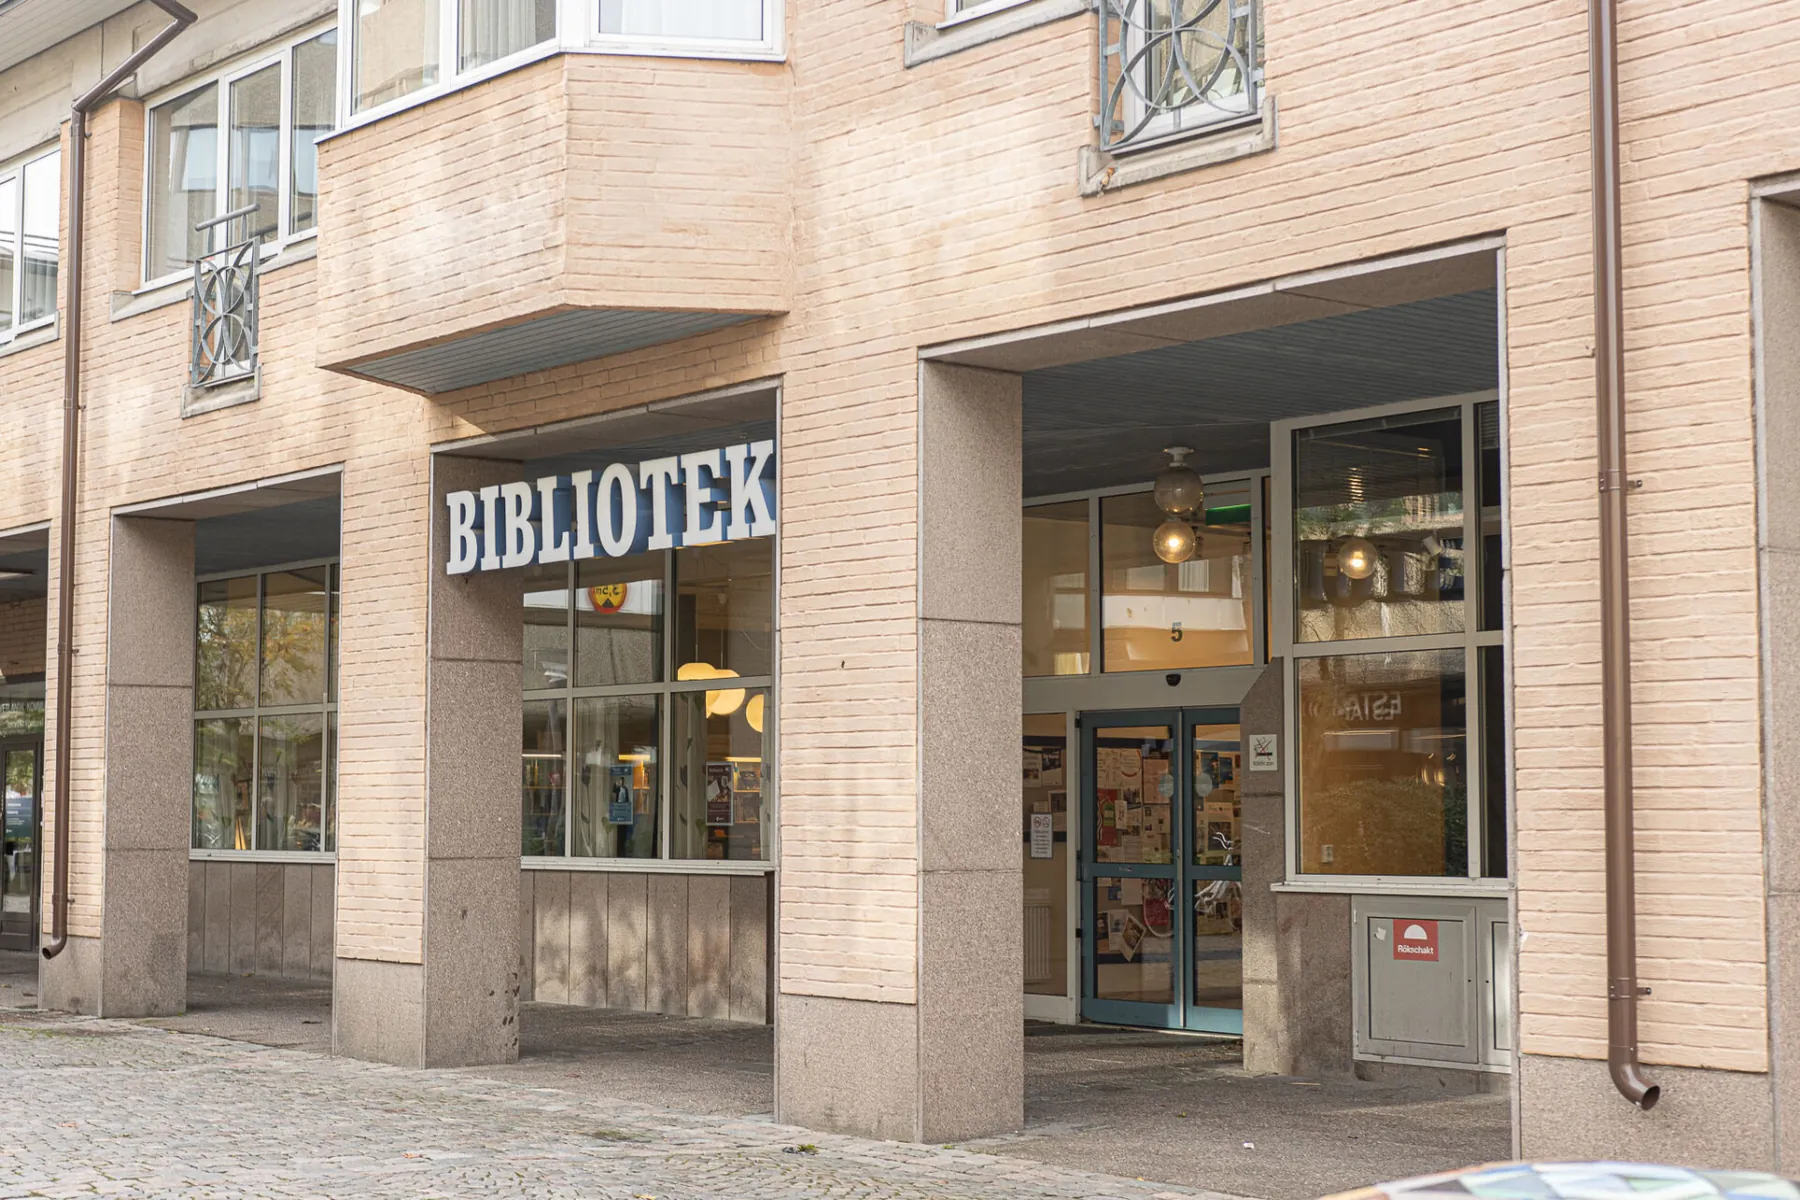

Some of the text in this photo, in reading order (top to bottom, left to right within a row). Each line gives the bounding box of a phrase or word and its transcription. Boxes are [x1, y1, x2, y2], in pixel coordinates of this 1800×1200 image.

[446, 439, 776, 575] BIBLIOTEK
[1171, 621, 1183, 642] 5
[1397, 944, 1434, 955] Rökschakt
